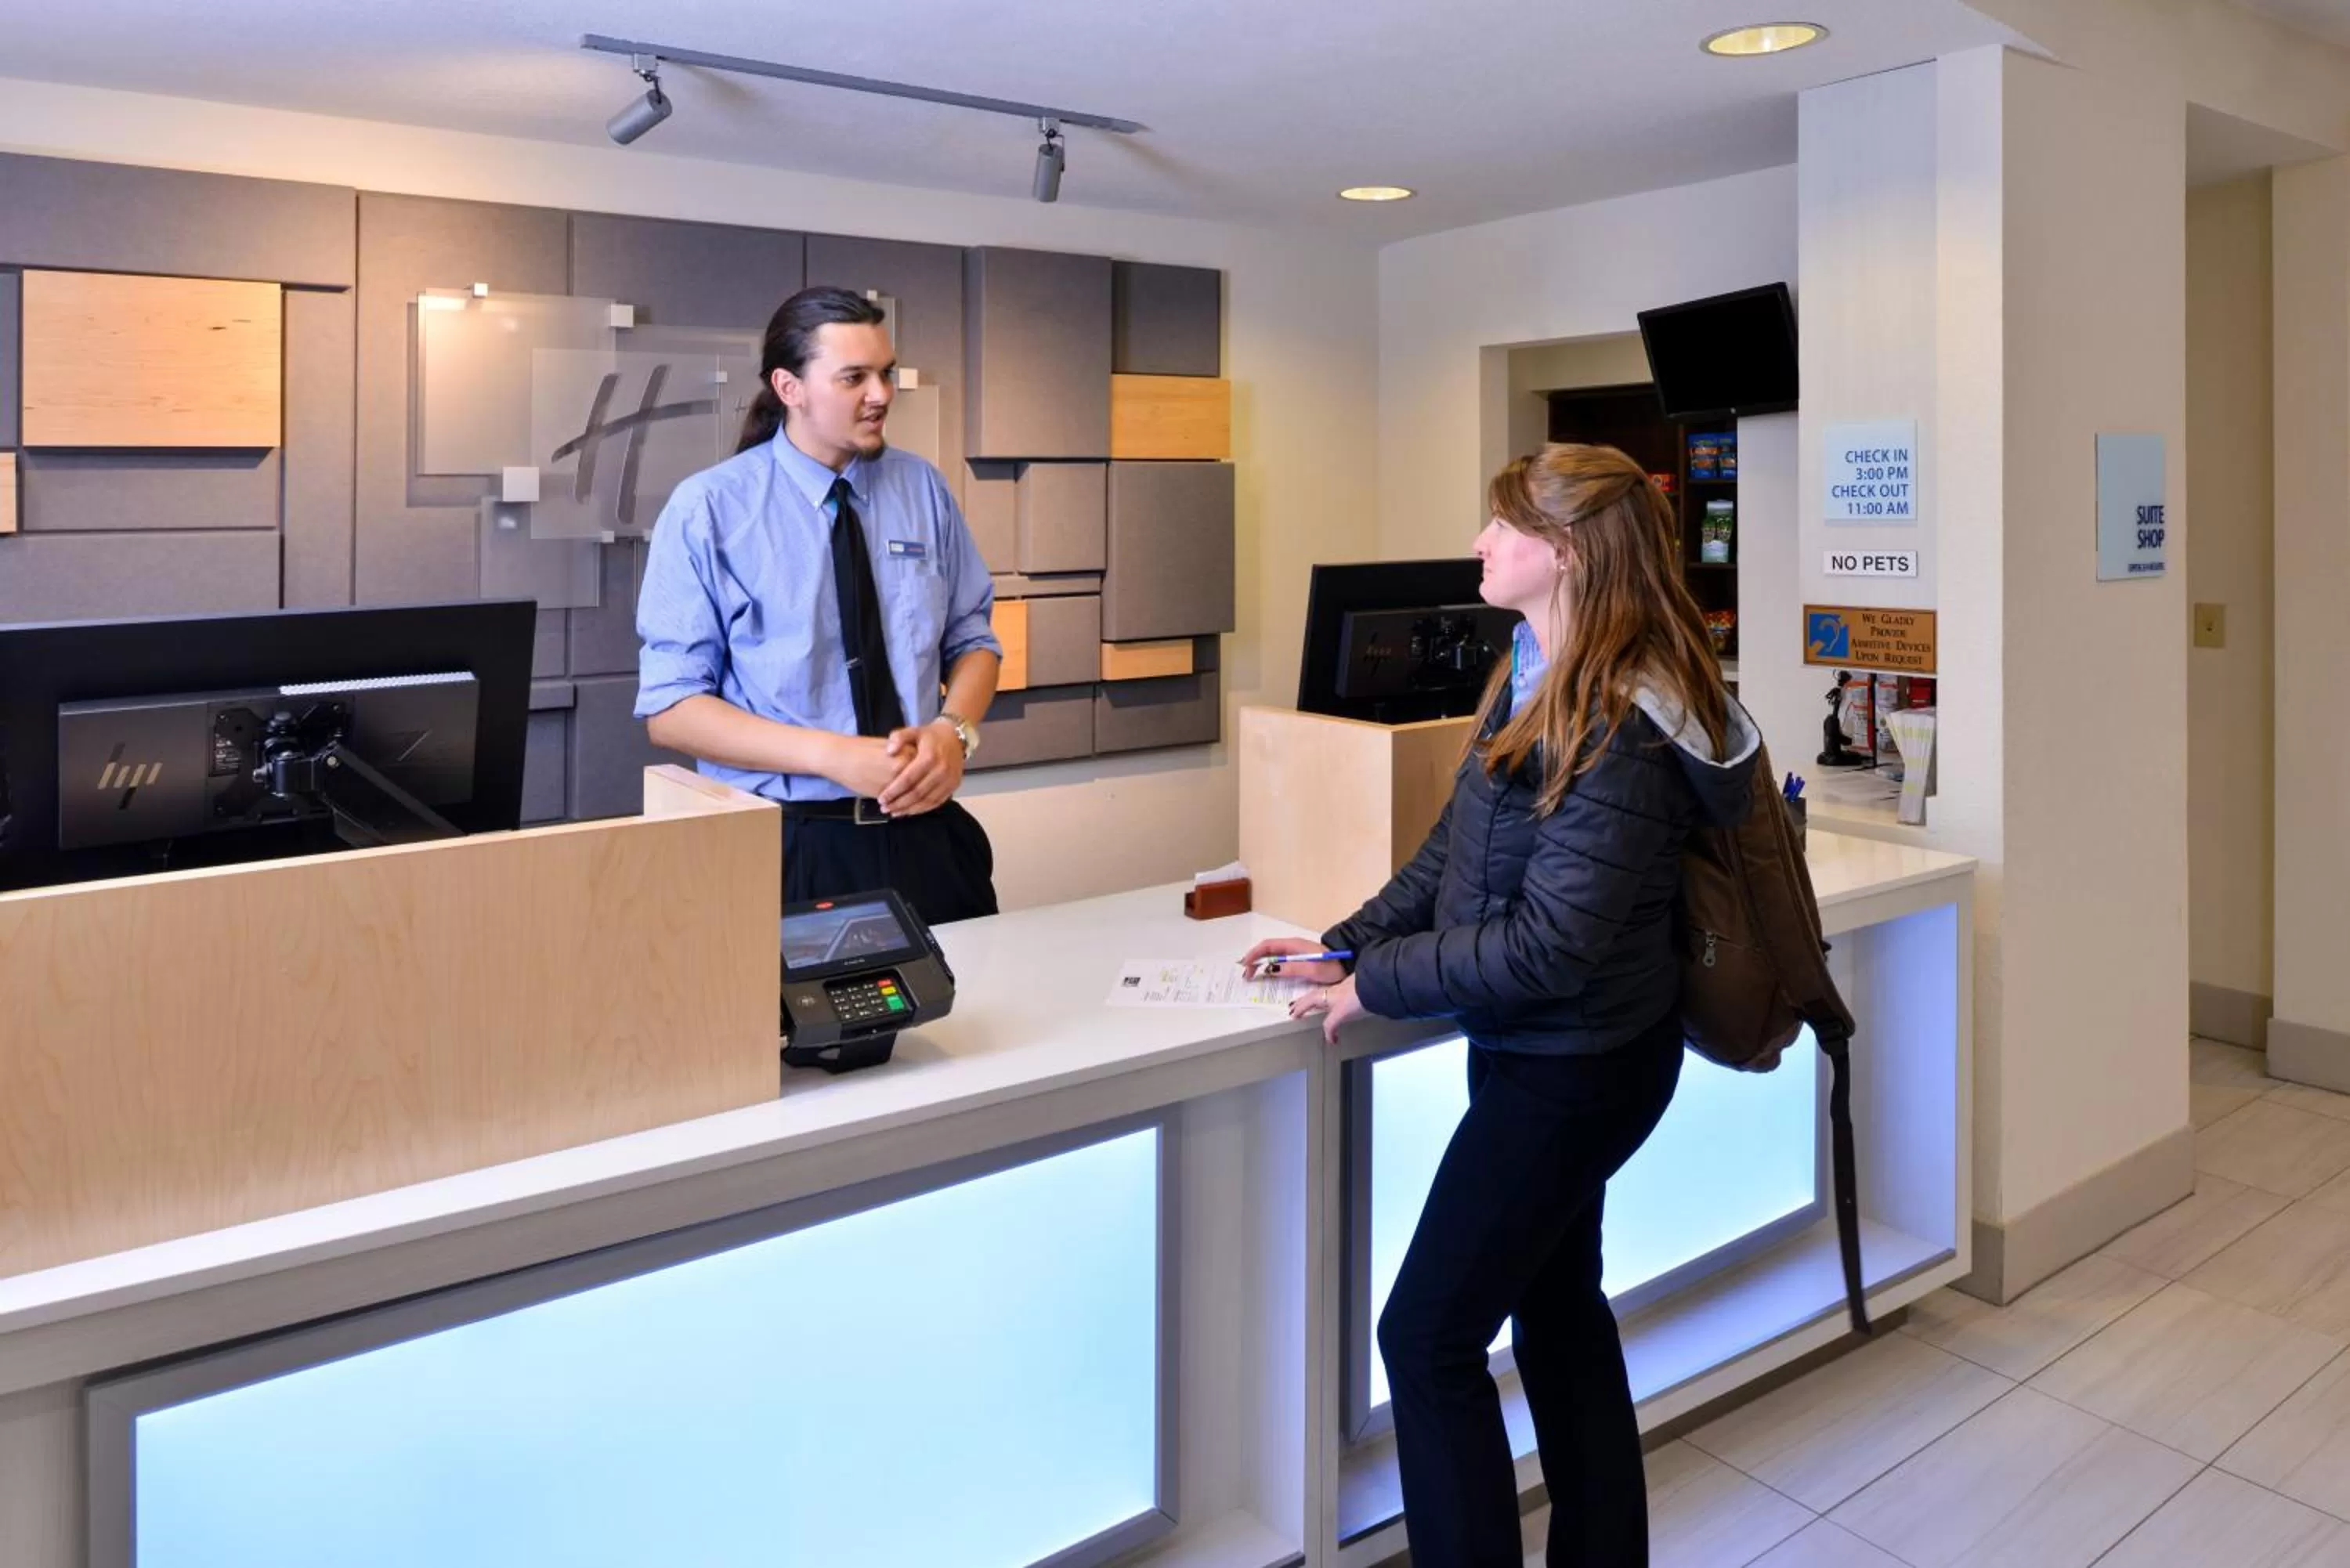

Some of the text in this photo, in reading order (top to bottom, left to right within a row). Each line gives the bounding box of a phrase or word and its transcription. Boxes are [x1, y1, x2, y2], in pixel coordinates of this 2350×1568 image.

[1845, 449, 1908, 464] CHECK IN
[1856, 466, 1908, 480] 3:00 PM
[1831, 483, 1909, 498] CHECK OUT
[1848, 501, 1909, 515] 11:00 AM
[2137, 505, 2164, 525] SUITE
[2137, 529, 2164, 549] SHOP
[1831, 555, 1909, 572] NO PETS
